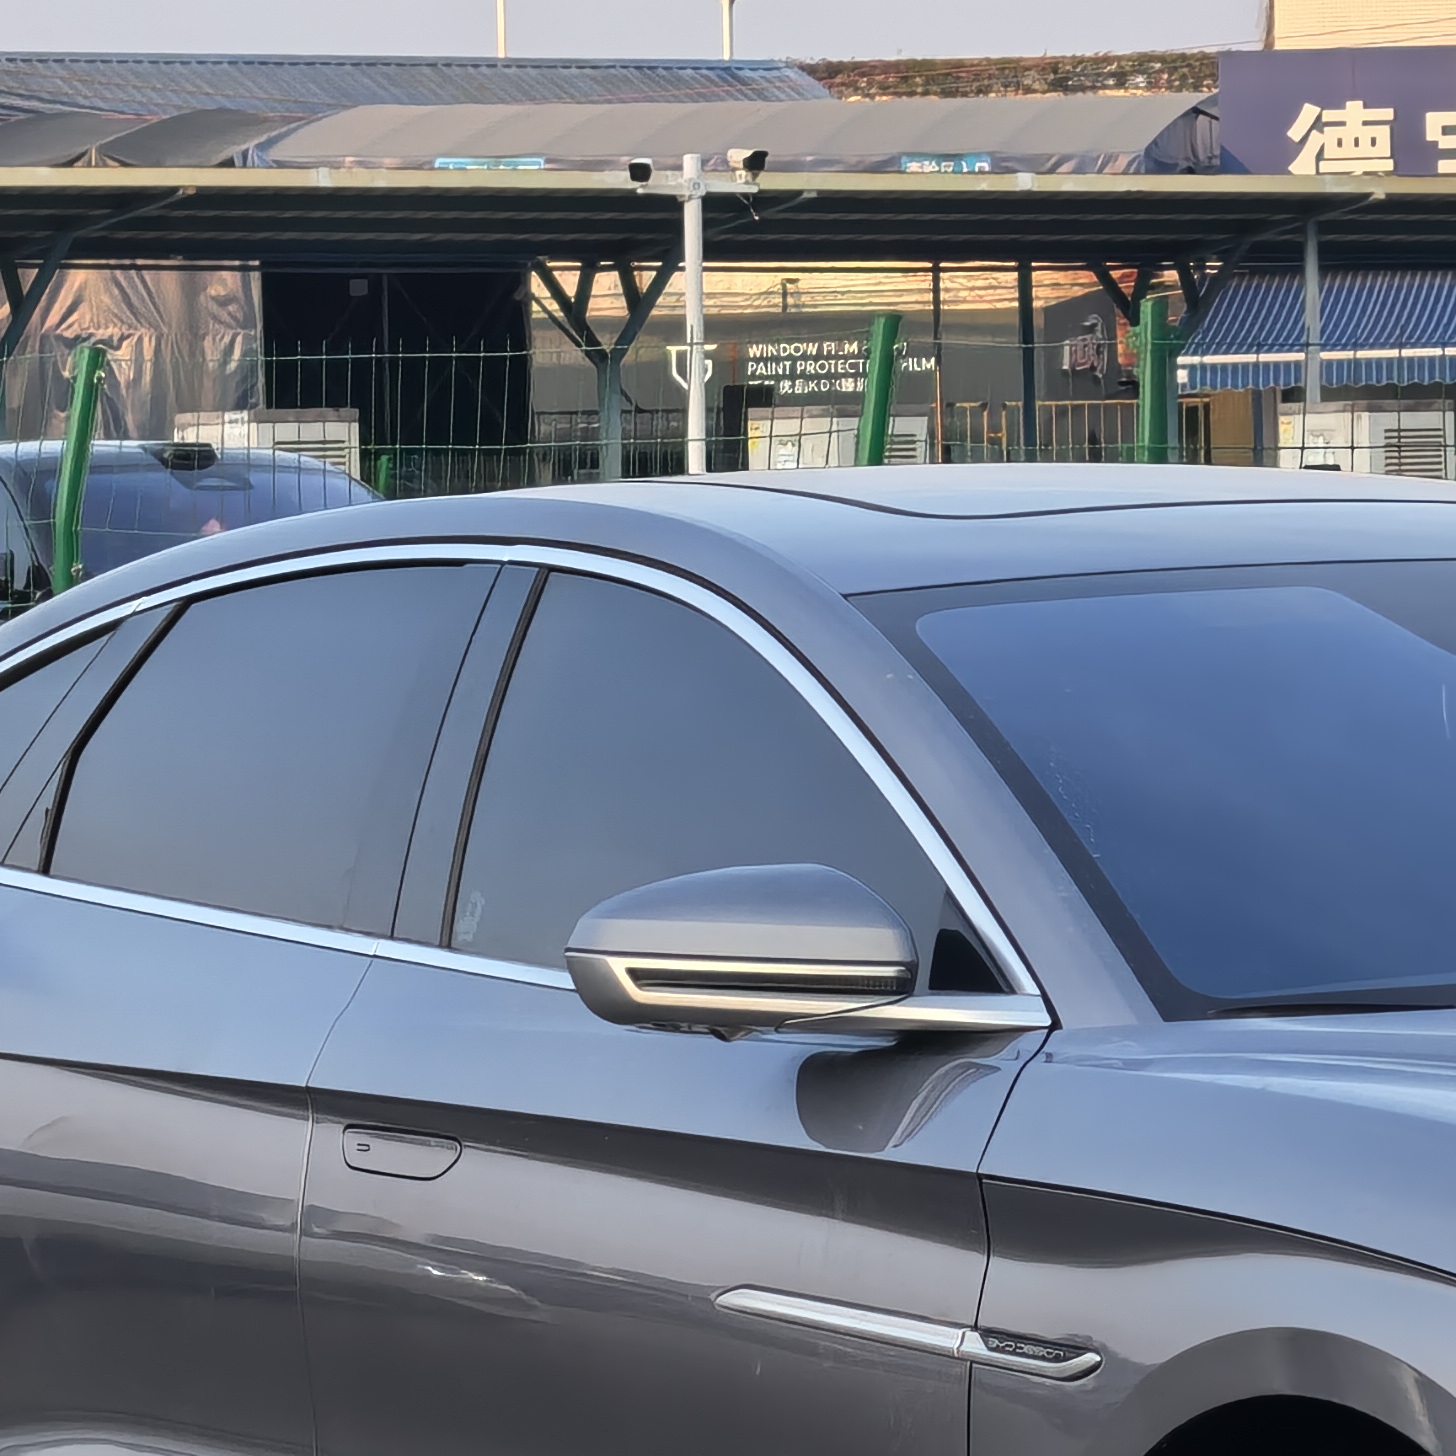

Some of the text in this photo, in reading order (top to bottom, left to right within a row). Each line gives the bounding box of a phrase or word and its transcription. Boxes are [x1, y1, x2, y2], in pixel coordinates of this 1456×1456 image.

[747, 342, 817, 357] WINDOW
[747, 359, 790, 376] PAINT
[796, 359, 870, 375] PROTECTI
